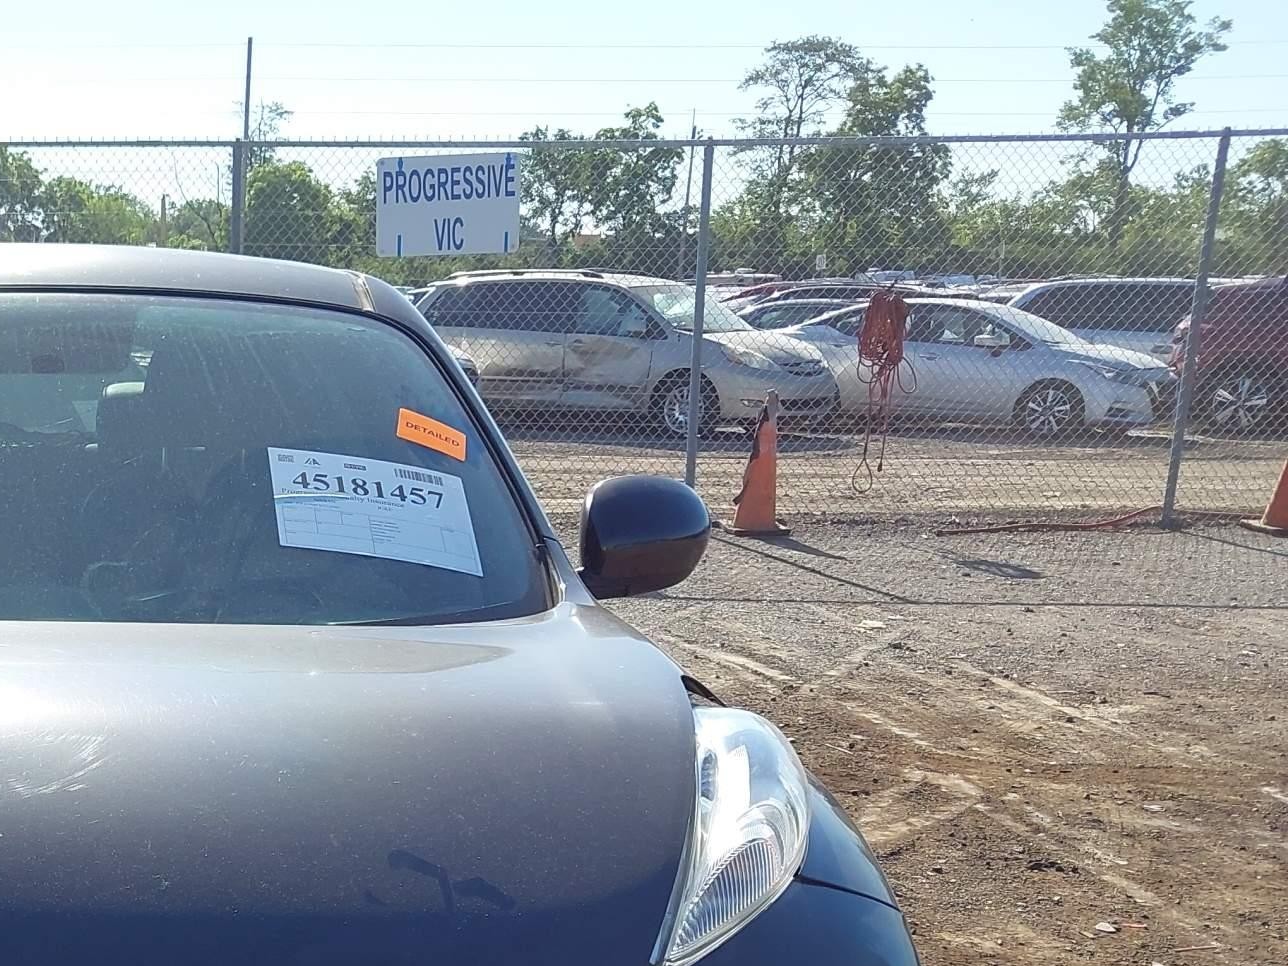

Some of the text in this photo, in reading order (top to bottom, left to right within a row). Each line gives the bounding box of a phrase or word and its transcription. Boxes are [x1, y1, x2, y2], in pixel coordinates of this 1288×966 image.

[383, 163, 516, 205] PROGRESSIVE
[433, 216, 465, 251] VIC
[405, 421, 460, 447] DETAILED
[292, 471, 444, 509] 45181457
